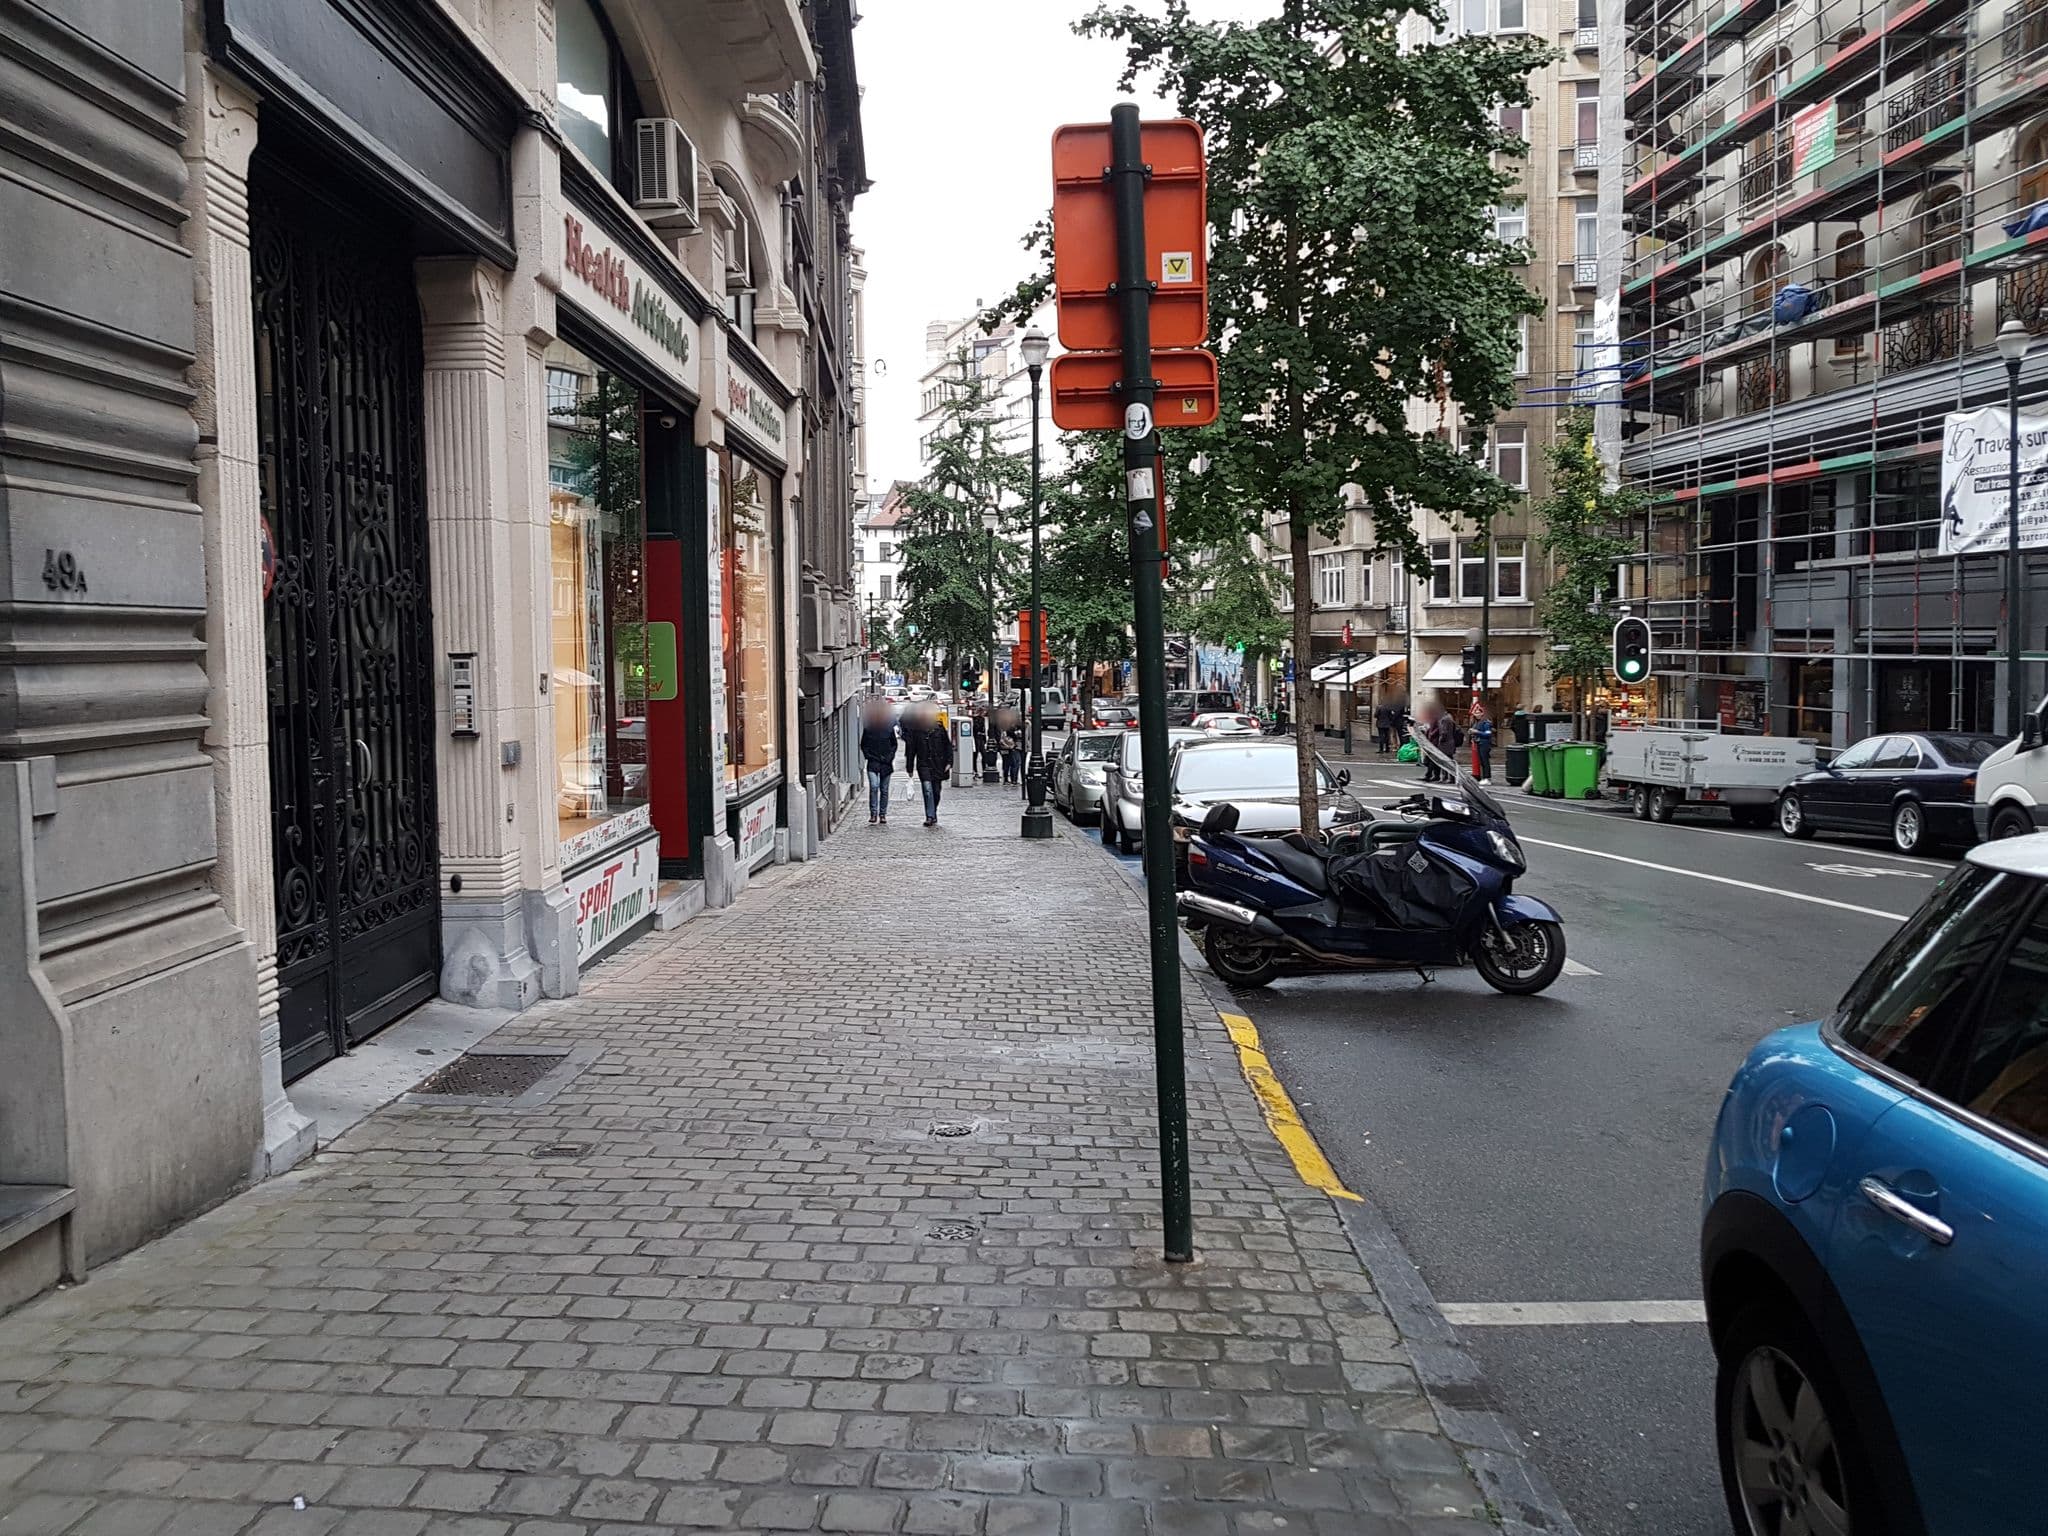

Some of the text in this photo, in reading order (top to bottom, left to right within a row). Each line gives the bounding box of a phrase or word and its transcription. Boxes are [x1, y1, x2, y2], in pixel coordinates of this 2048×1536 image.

[566, 212, 689, 366] Health Attitude
[2026, 431, 2048, 448] sur
[577, 861, 623, 926] SPORT
